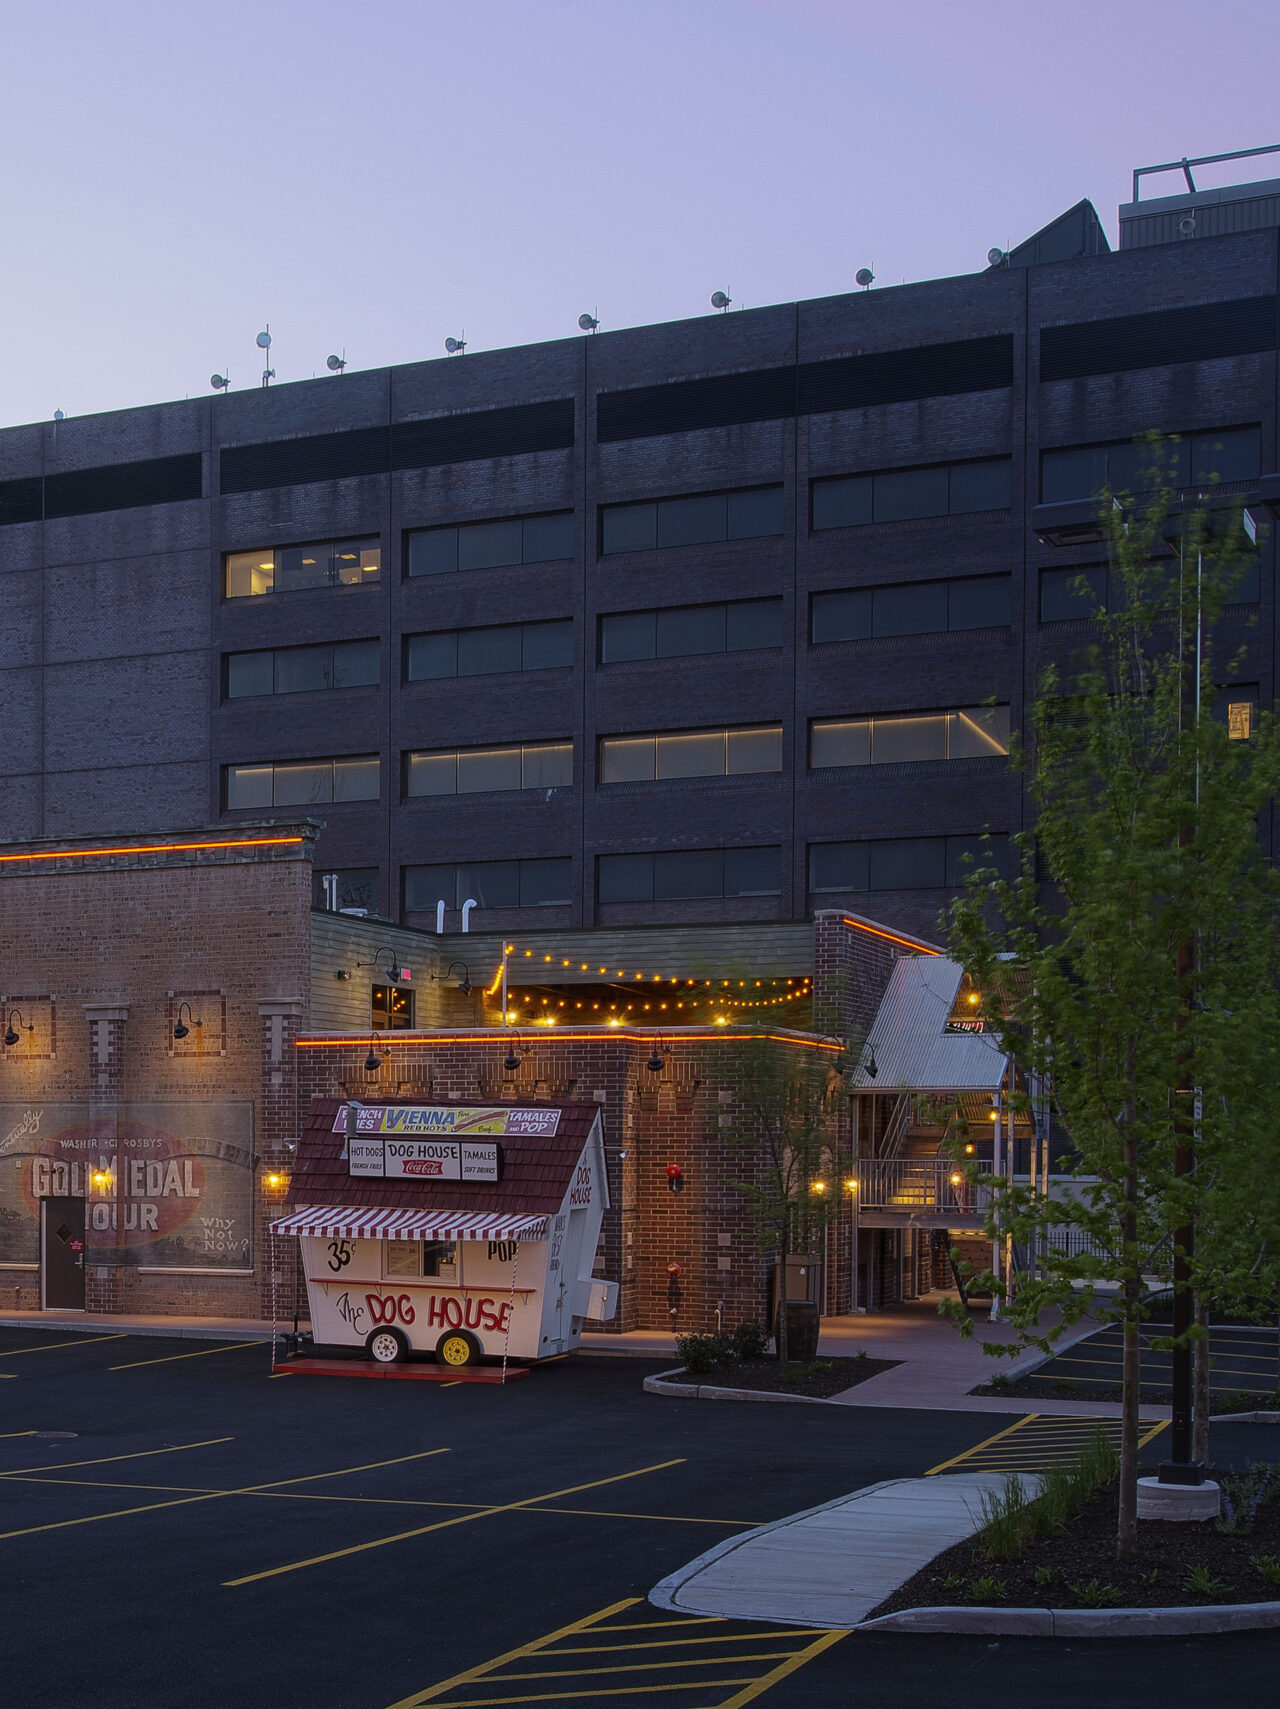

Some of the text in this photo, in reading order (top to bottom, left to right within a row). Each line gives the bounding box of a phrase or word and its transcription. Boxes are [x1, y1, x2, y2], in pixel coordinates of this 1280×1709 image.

[342, 1109, 382, 1119] FENCH
[386, 1109, 456, 1130] VIENNA
[508, 1111, 558, 1122] TAMALES
[422, 1125, 448, 1133] HOTS
[520, 1121, 548, 1132] POP
[351, 1146, 384, 1157] HOT DOGS
[387, 1143, 459, 1159] DOG HOUSE
[463, 1150, 497, 1161] TAMALES
[351, 1162, 369, 1170] FRENCH
[463, 1166, 496, 1175] SOFT DRINKS
[569, 1186, 592, 1206] HOUSE
[200, 1216, 236, 1231] Why
[203, 1228, 233, 1241] Not
[487, 1240, 518, 1263] POP
[336, 1291, 515, 1336] The DOG HOUSE
